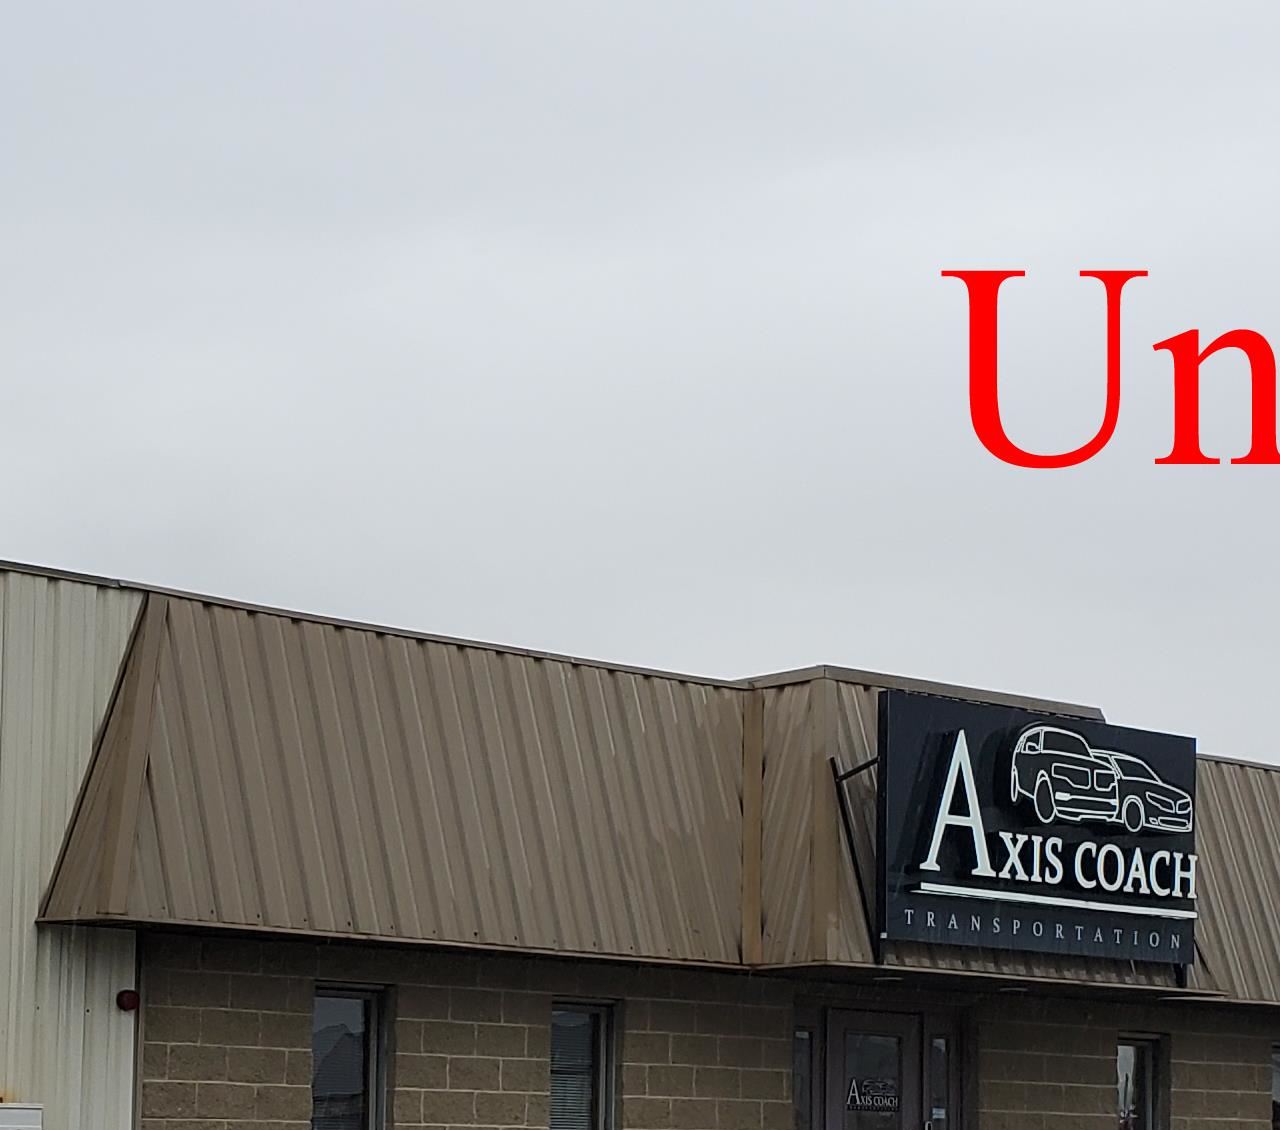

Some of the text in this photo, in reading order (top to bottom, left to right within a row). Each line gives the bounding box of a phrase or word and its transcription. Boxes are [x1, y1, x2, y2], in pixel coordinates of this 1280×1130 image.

[919, 729, 1199, 899] AXIS COACH
[904, 908, 1181, 949] TRANSPORTATION
